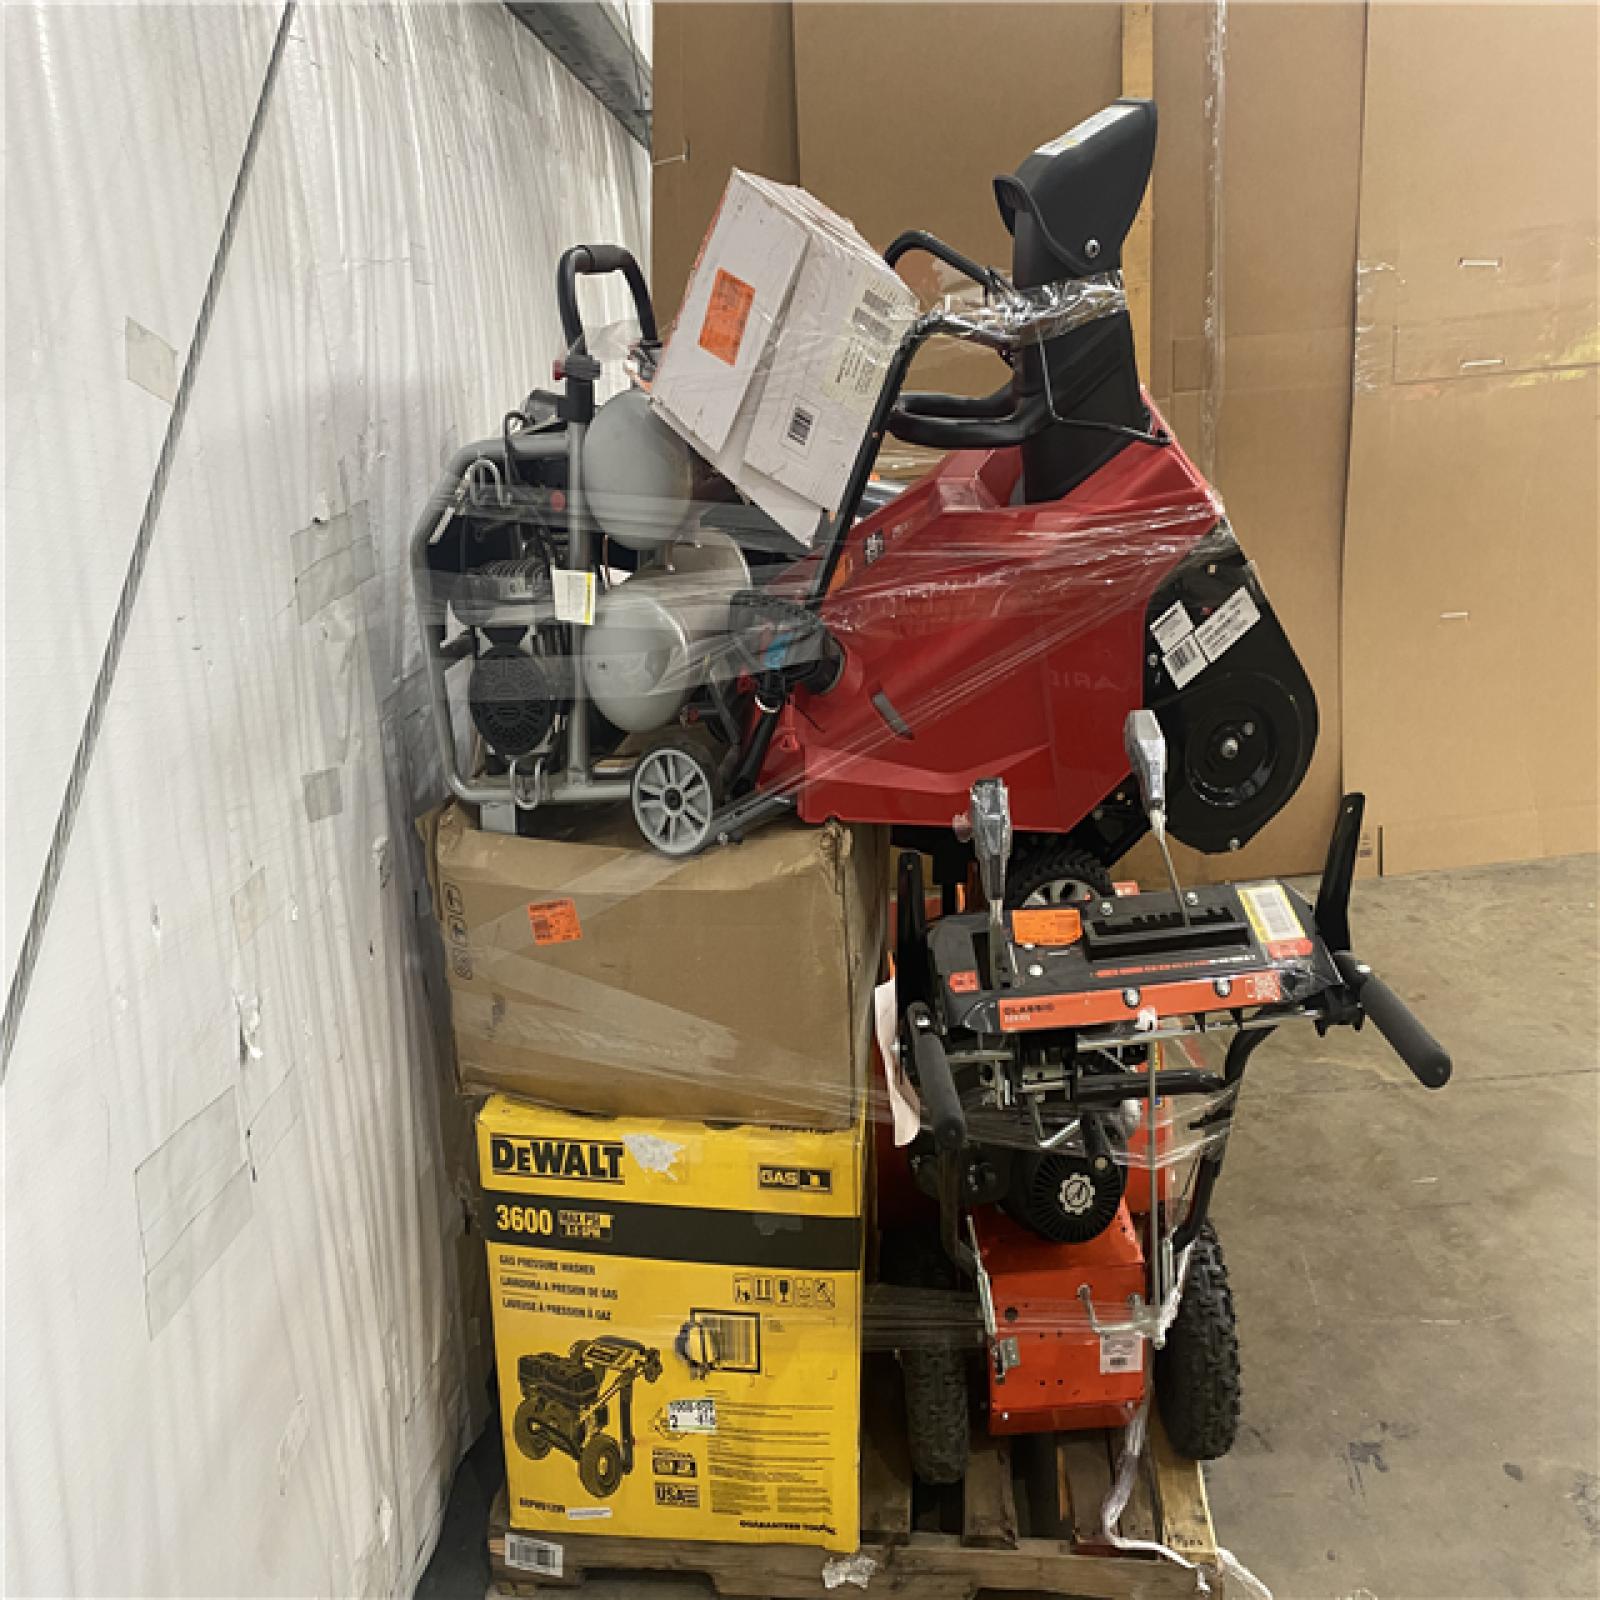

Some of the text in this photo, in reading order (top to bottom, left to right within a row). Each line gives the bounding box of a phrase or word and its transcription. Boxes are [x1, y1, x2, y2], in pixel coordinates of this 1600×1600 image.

[760, 1169, 799, 1186] GAS
[495, 1203, 553, 1236] 3600
[517, 1256, 558, 1271] PRESSURE
[559, 1262, 596, 1276] WASHER
[739, 1519, 801, 1531] GUARANTEED
